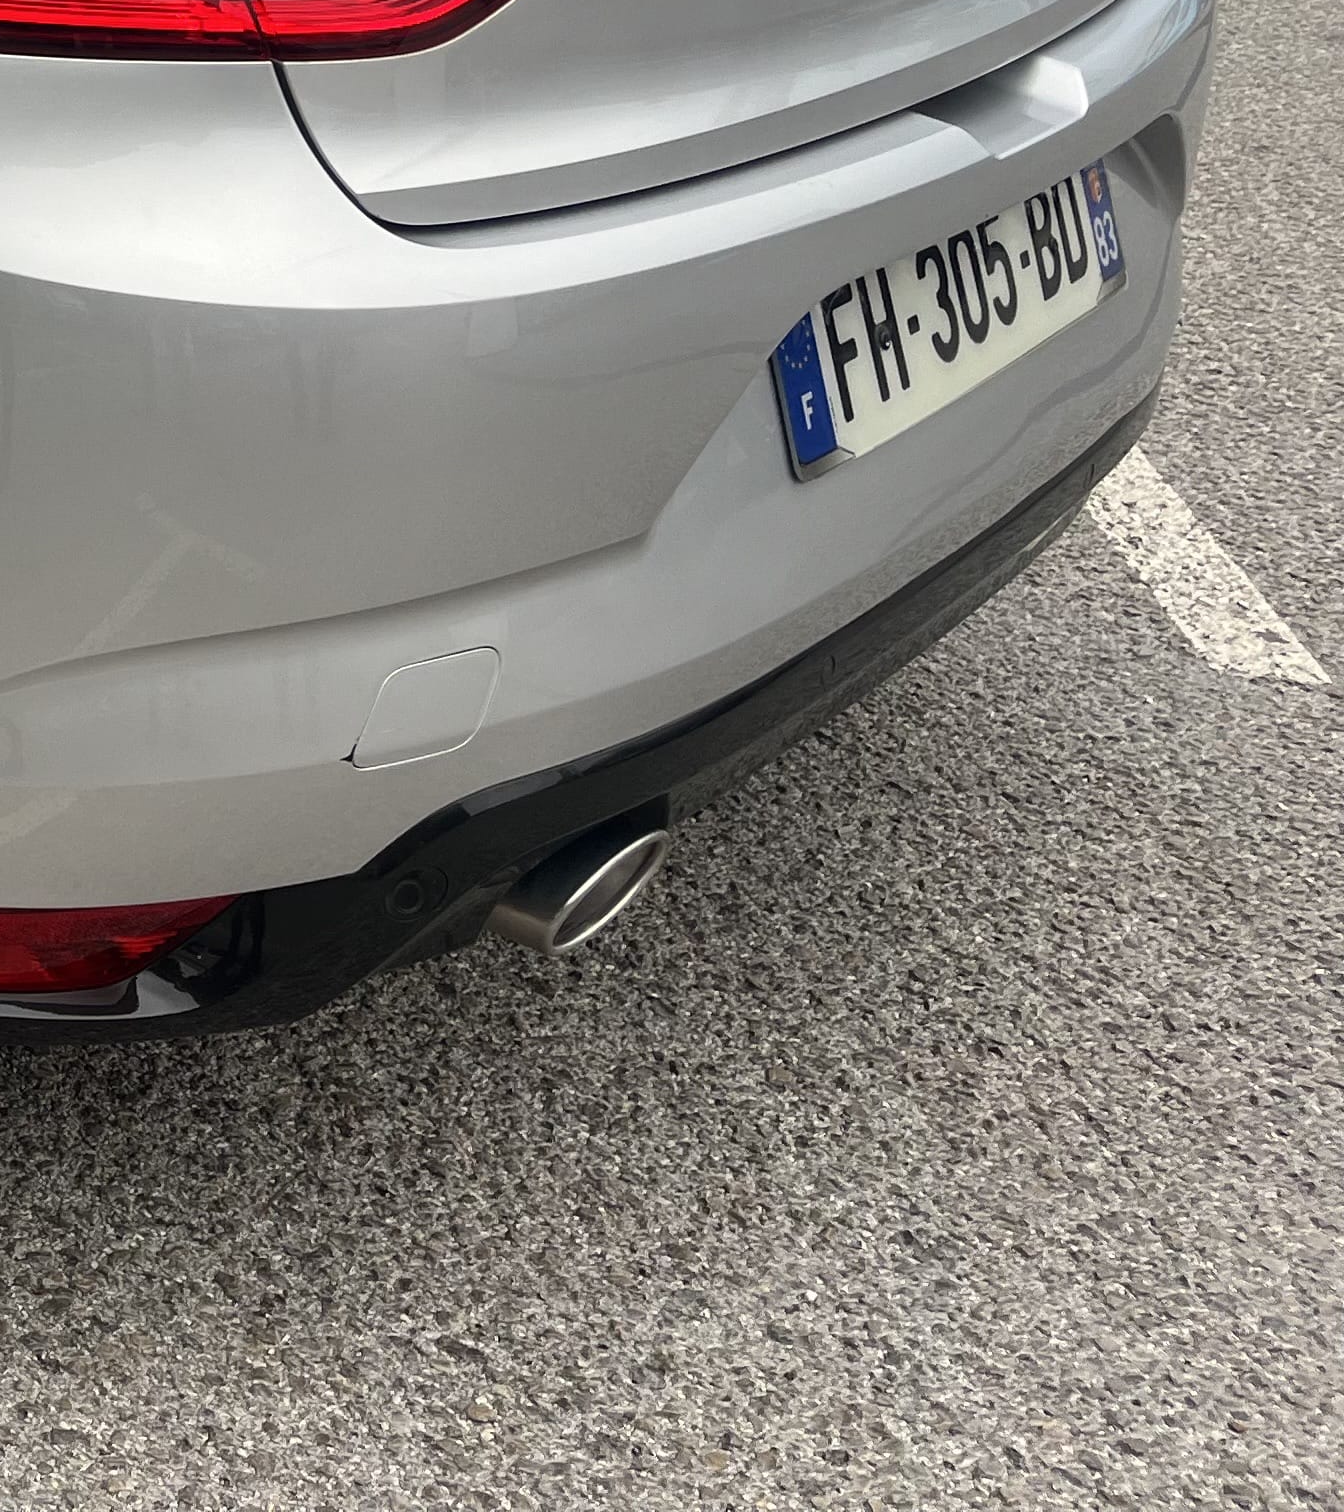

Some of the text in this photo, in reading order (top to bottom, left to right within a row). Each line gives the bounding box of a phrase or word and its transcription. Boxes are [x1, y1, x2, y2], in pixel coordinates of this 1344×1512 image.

[800, 390, 814, 431] F
[820, 175, 1089, 423] FH-305-BD
[1093, 210, 1118, 267] 83
